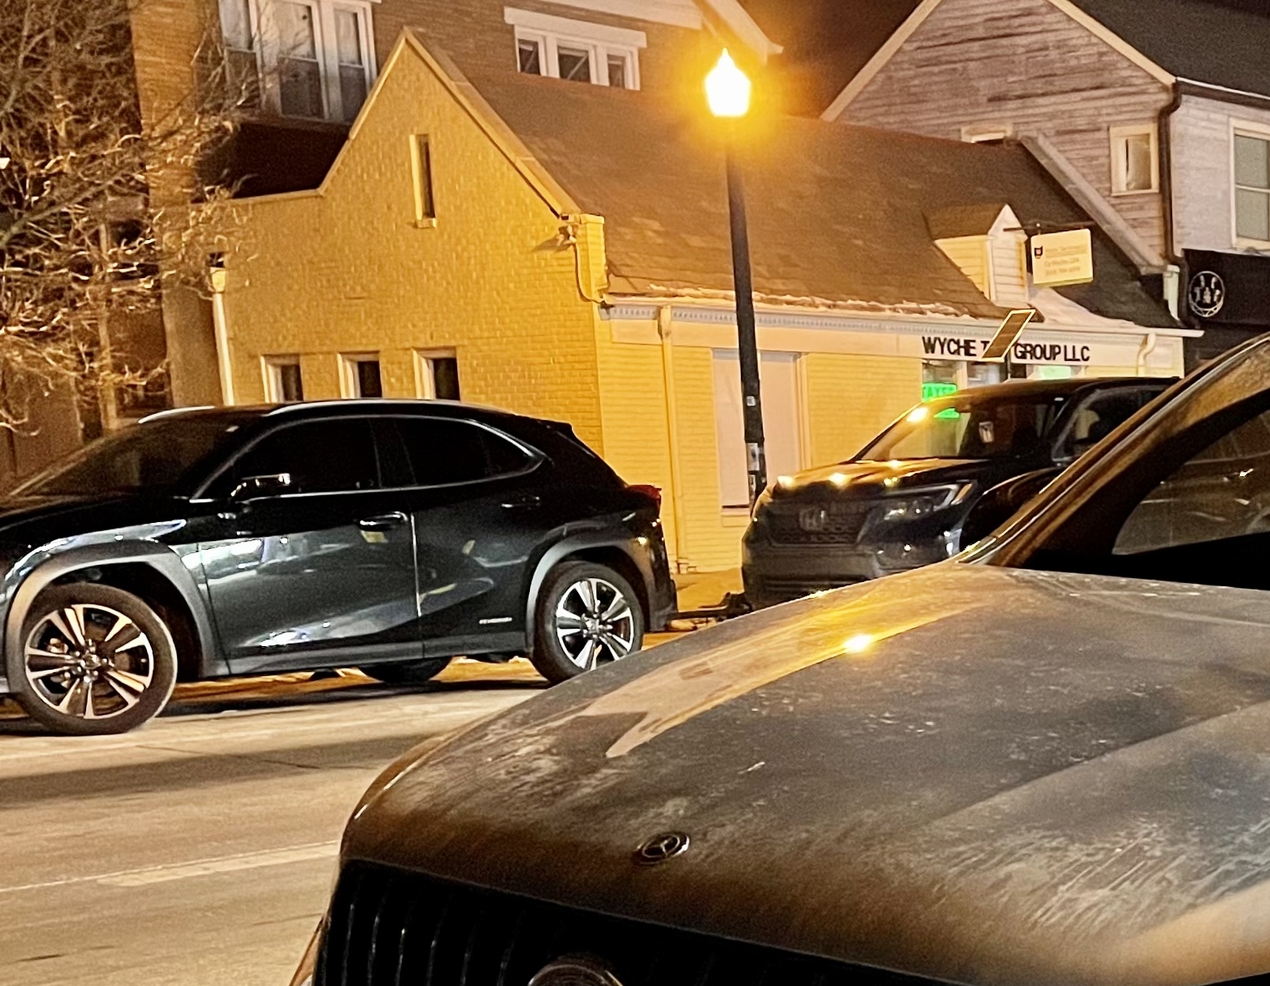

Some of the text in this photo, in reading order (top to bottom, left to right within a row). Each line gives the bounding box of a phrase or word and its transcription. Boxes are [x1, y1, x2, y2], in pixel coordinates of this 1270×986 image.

[922, 336, 976, 357] WYCHE
[1014, 343, 1061, 361] GROUP
[1063, 345, 1090, 362] LLC
